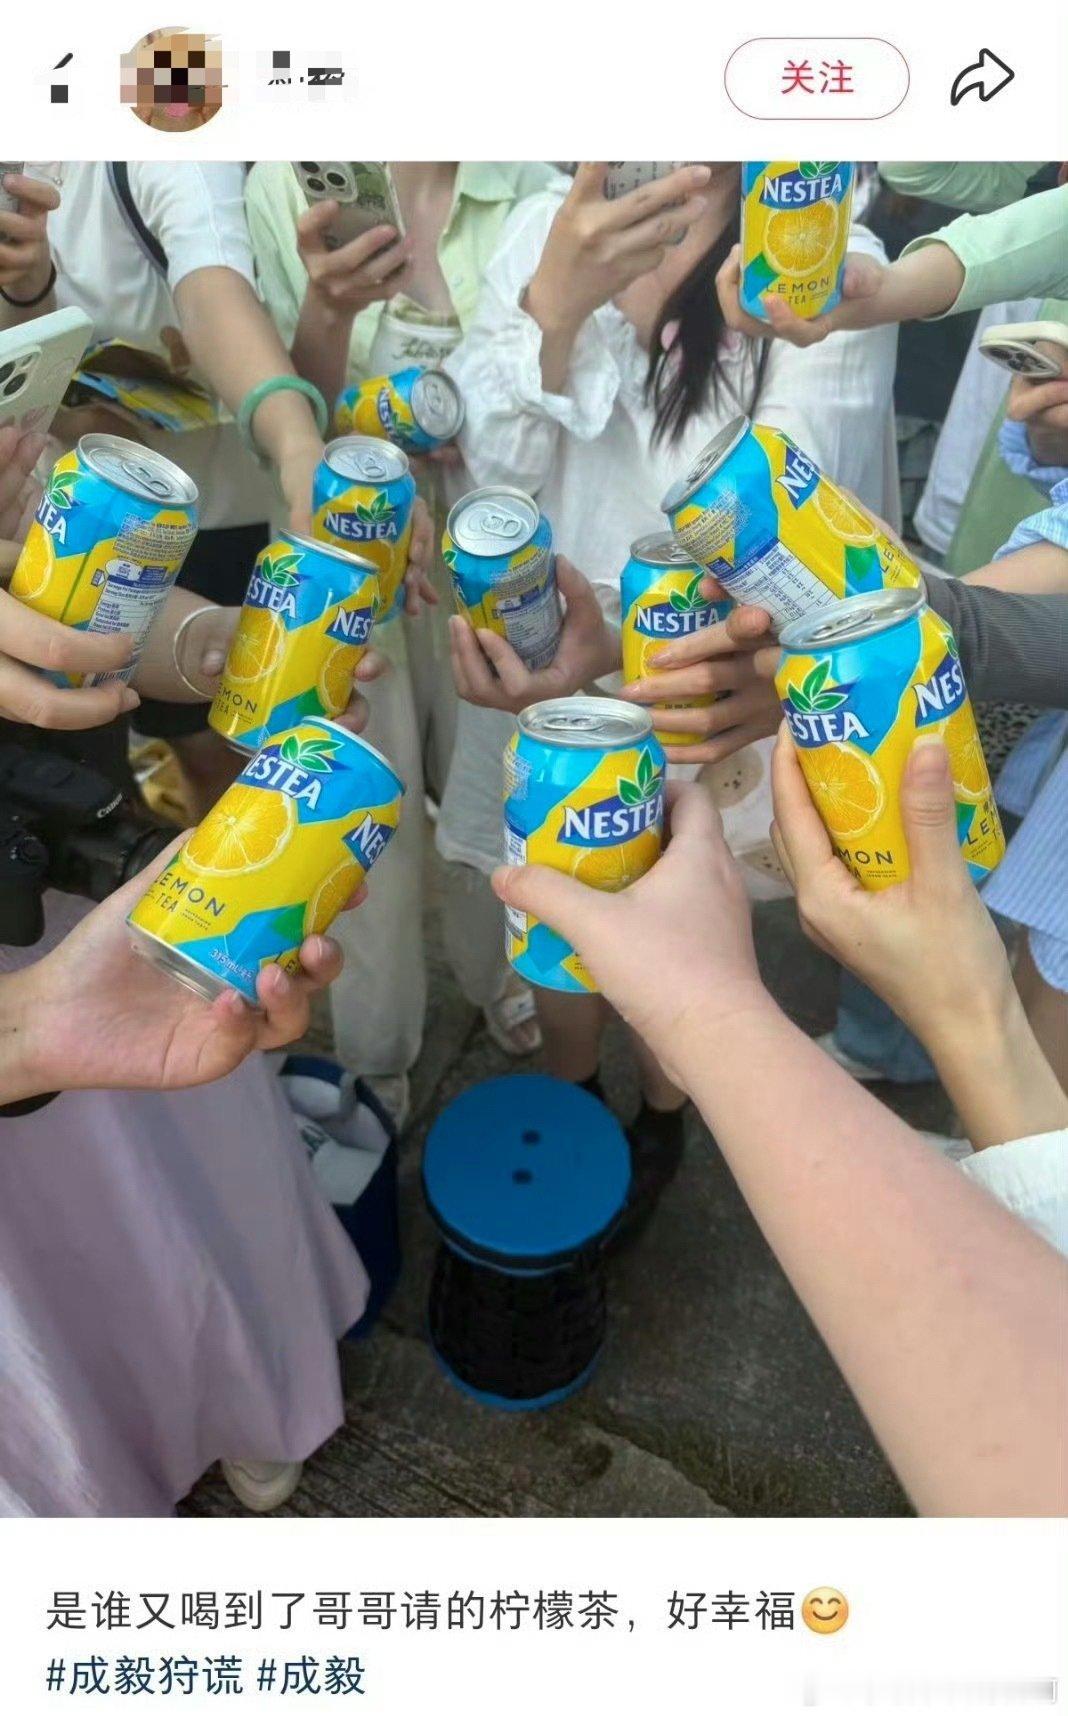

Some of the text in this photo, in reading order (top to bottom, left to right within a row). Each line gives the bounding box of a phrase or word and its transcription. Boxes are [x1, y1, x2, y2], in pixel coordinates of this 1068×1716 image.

[763, 174, 843, 203] NESTEA
[766, 277, 830, 293] LEMON
[788, 295, 806, 304] TEA
[38, 492, 66, 544] TEA
[325, 510, 398, 539] NESTEA
[333, 606, 375, 639] NES
[637, 604, 719, 633] NESTEA
[914, 660, 966, 718] NES
[242, 752, 322, 810] ESTEA
[565, 795, 663, 840] NESTEA
[837, 849, 893, 865] MON
[156, 892, 178, 912] TEA
